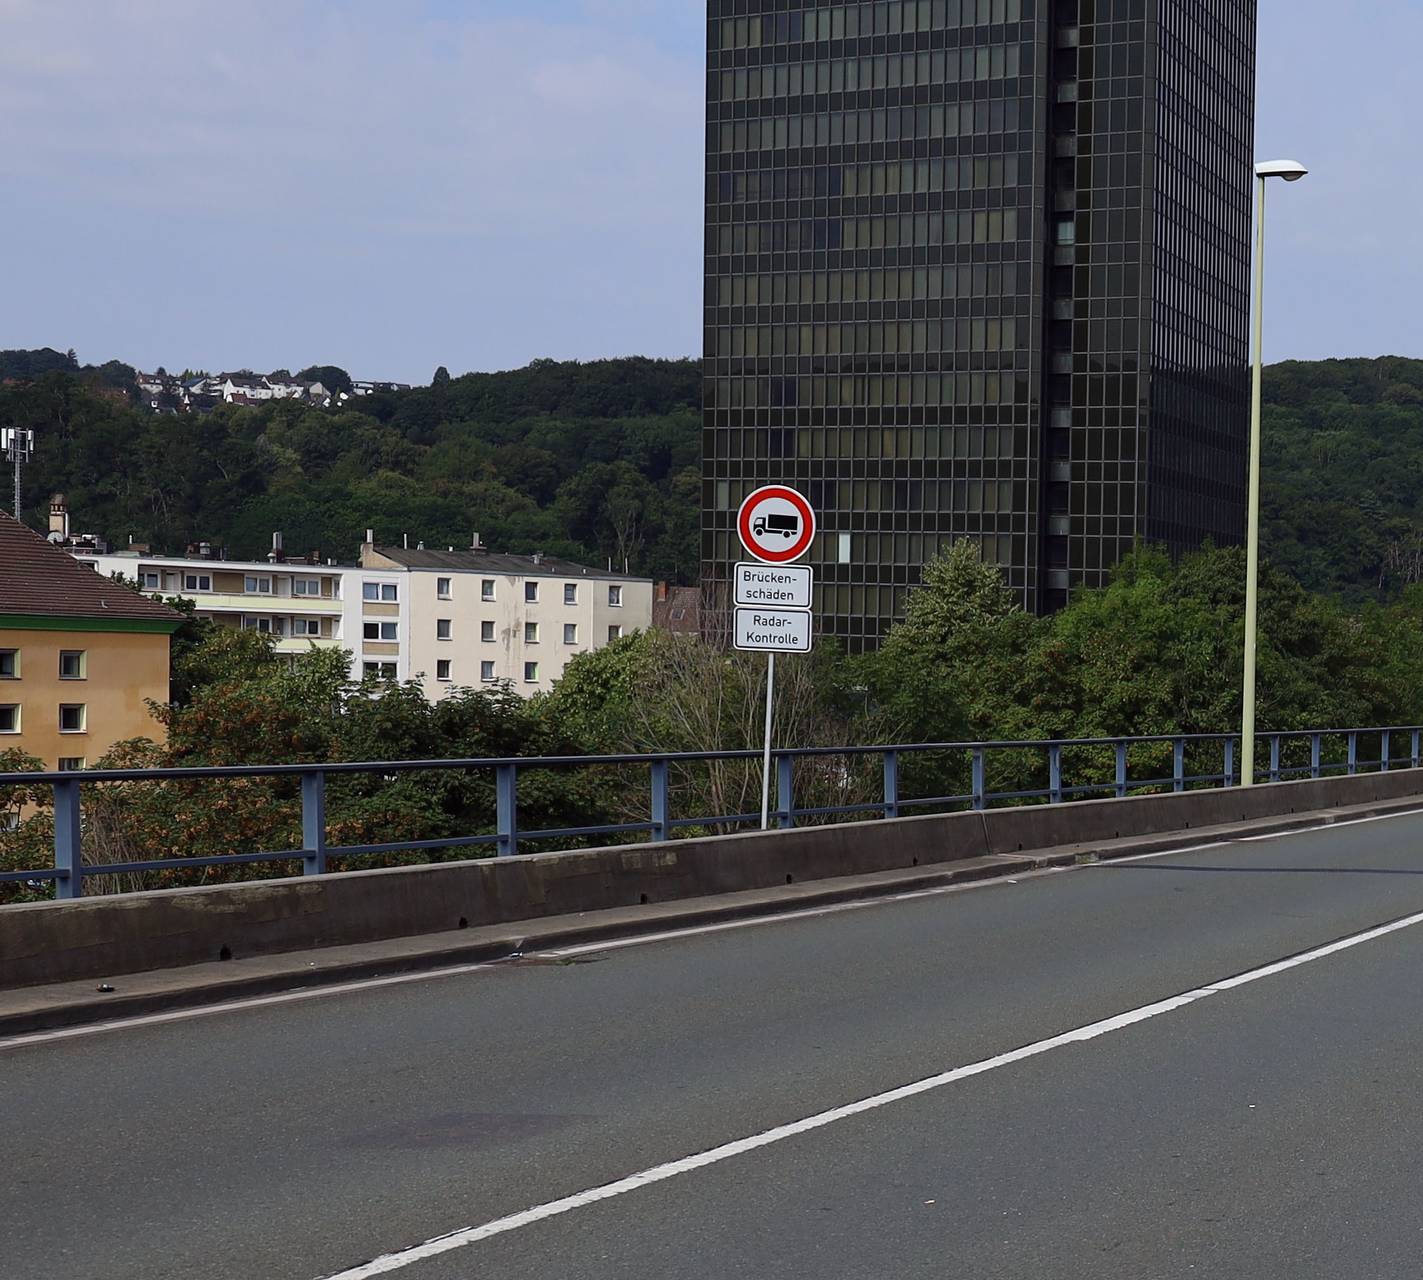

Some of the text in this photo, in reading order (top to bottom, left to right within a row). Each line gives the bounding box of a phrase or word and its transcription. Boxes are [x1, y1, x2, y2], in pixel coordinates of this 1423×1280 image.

[743, 570, 797, 584] Brücken-
[746, 588, 794, 600] schäden
[753, 614, 792, 627] Radar-
[746, 632, 798, 645] Kontrolle
